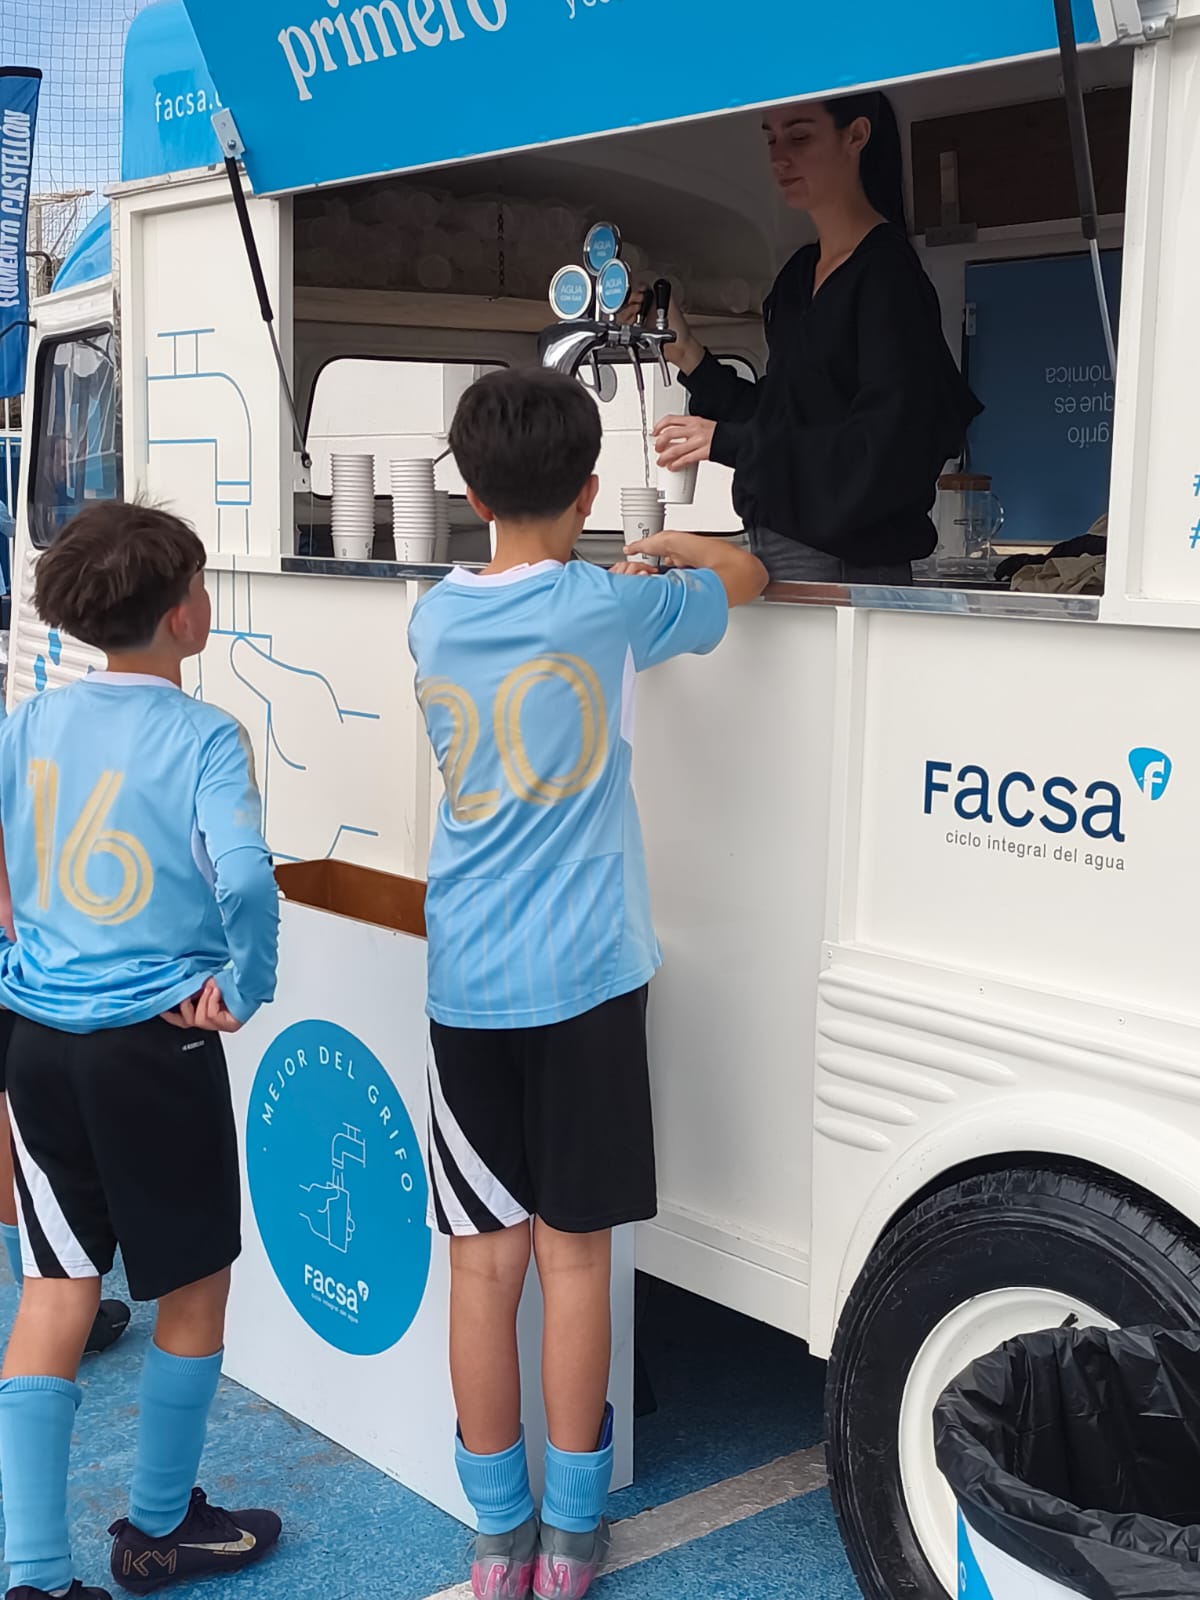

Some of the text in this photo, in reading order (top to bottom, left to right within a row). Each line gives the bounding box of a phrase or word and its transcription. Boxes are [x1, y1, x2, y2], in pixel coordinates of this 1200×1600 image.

[278, 0, 507, 101] primero
[560, 284, 582, 294] AGUA
[1054, 396, 1076, 413] es
[1067, 422, 1109, 448] grifo
[416, 652, 608, 821] 20
[923, 760, 1125, 843] Facsa
[27, 759, 154, 926] 16
[945, 829, 1125, 871] ciclo integral del agua
[262, 1046, 413, 1192] MEJOR DEL GRIFO
[304, 1263, 359, 1314] Facsa
